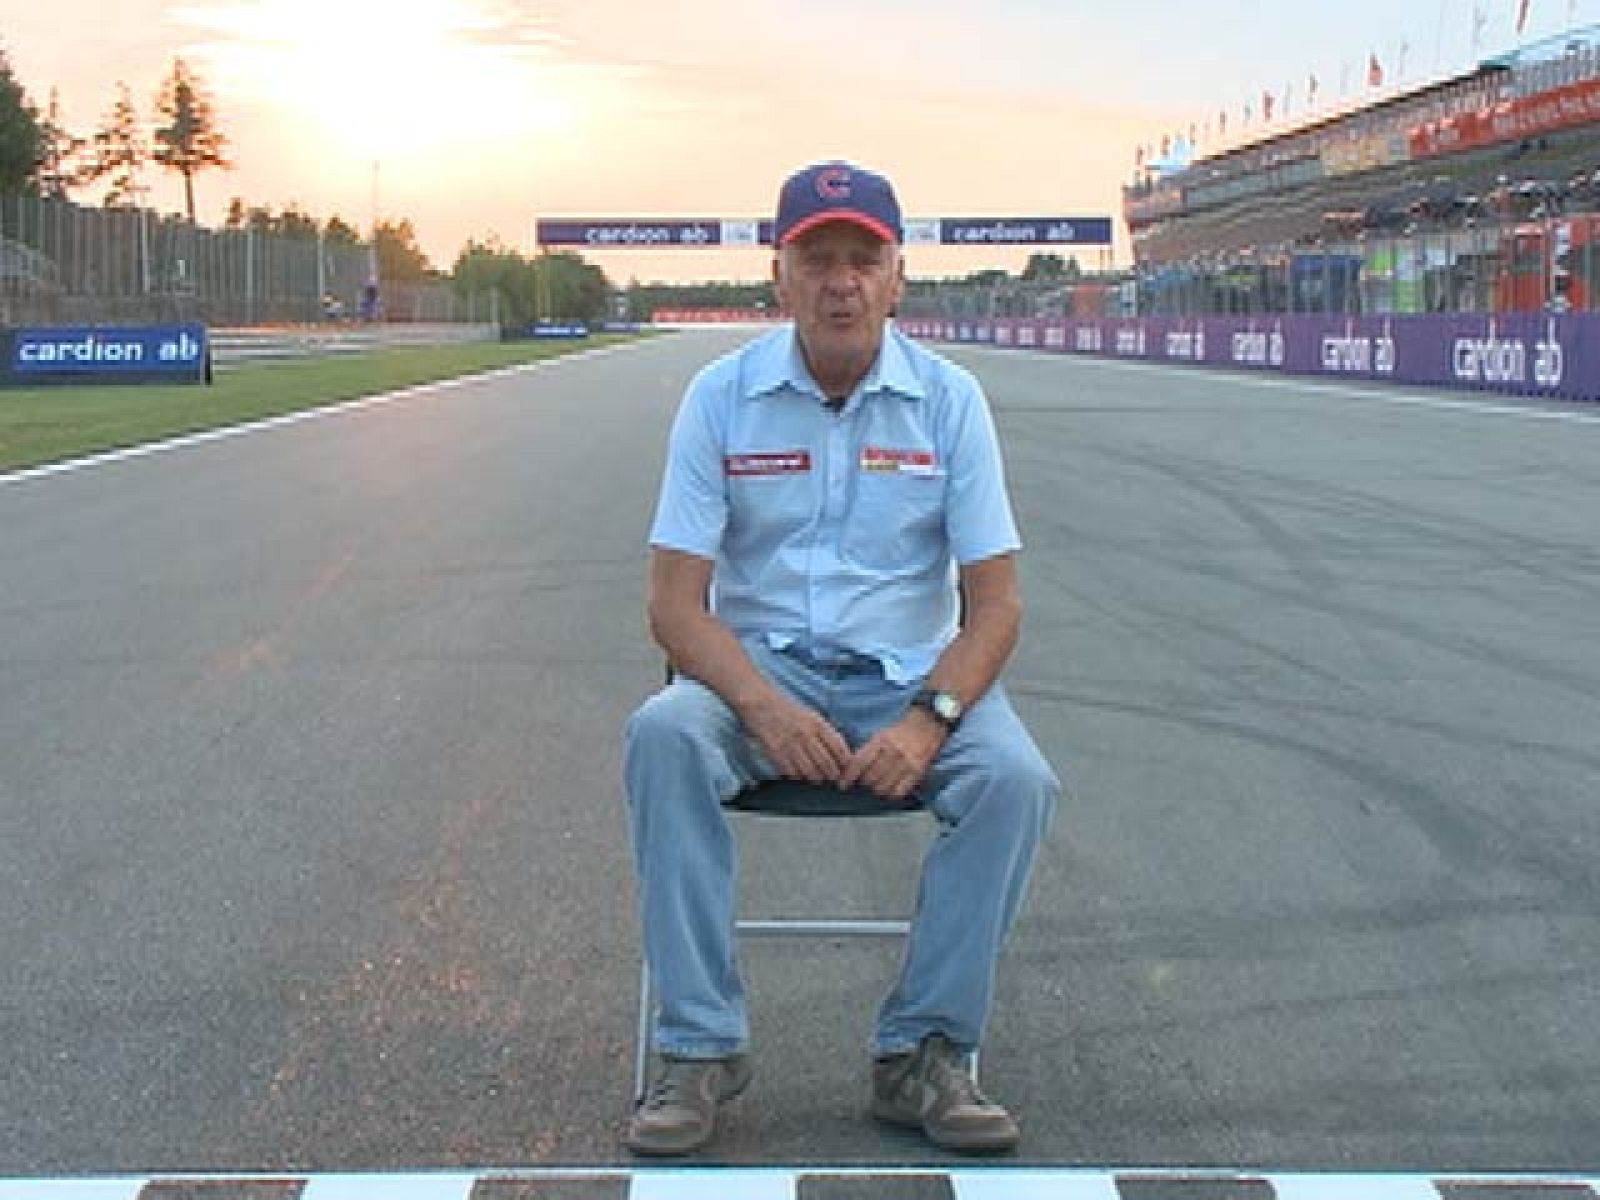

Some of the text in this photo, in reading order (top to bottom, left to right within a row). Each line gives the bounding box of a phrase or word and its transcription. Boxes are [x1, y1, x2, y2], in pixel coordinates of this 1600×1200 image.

[585, 223, 670, 243] cardion
[679, 223, 709, 243] ab
[952, 222, 1036, 242] cardion
[19, 331, 199, 361] cardion ab
[1454, 315, 1562, 386] cardion ab
